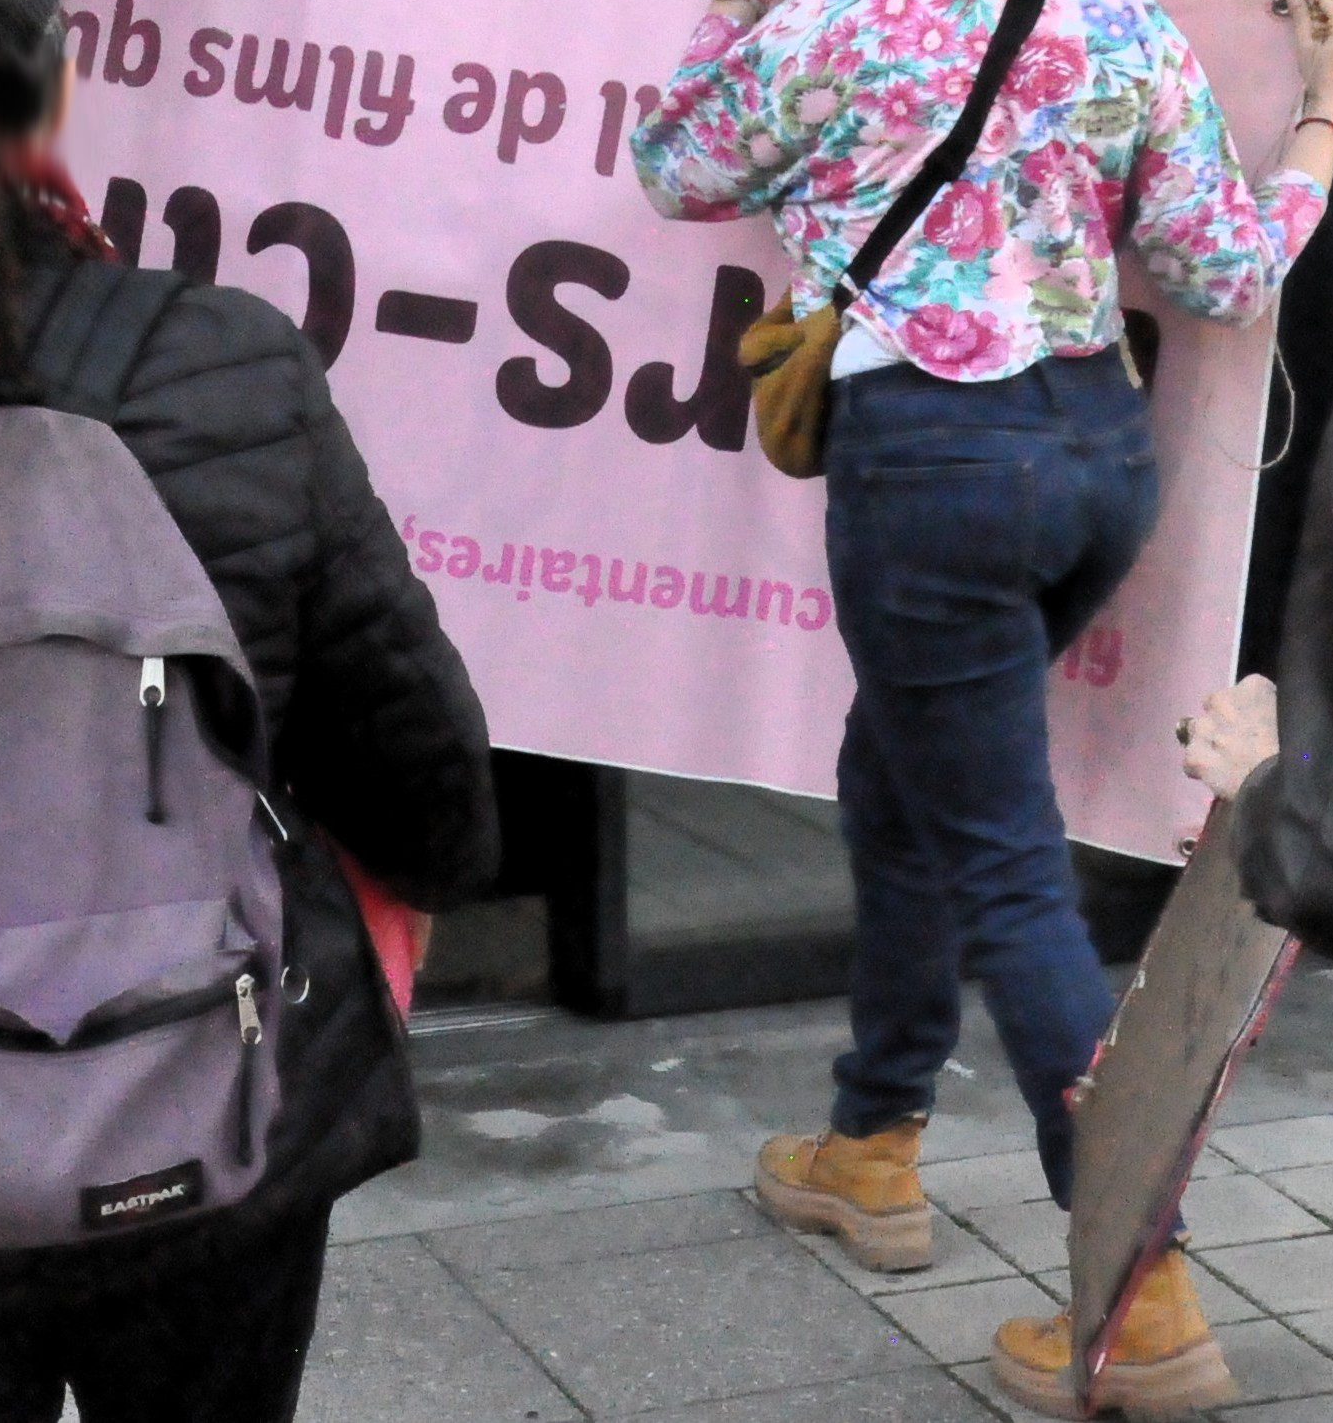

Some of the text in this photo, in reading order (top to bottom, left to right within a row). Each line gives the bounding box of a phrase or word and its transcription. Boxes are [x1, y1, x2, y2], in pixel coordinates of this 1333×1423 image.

[184, 27, 415, 146] films
[442, 62, 566, 164] de
[400, 515, 832, 631] cumentaires,
[100, 1183, 185, 1216] EASTPAK
